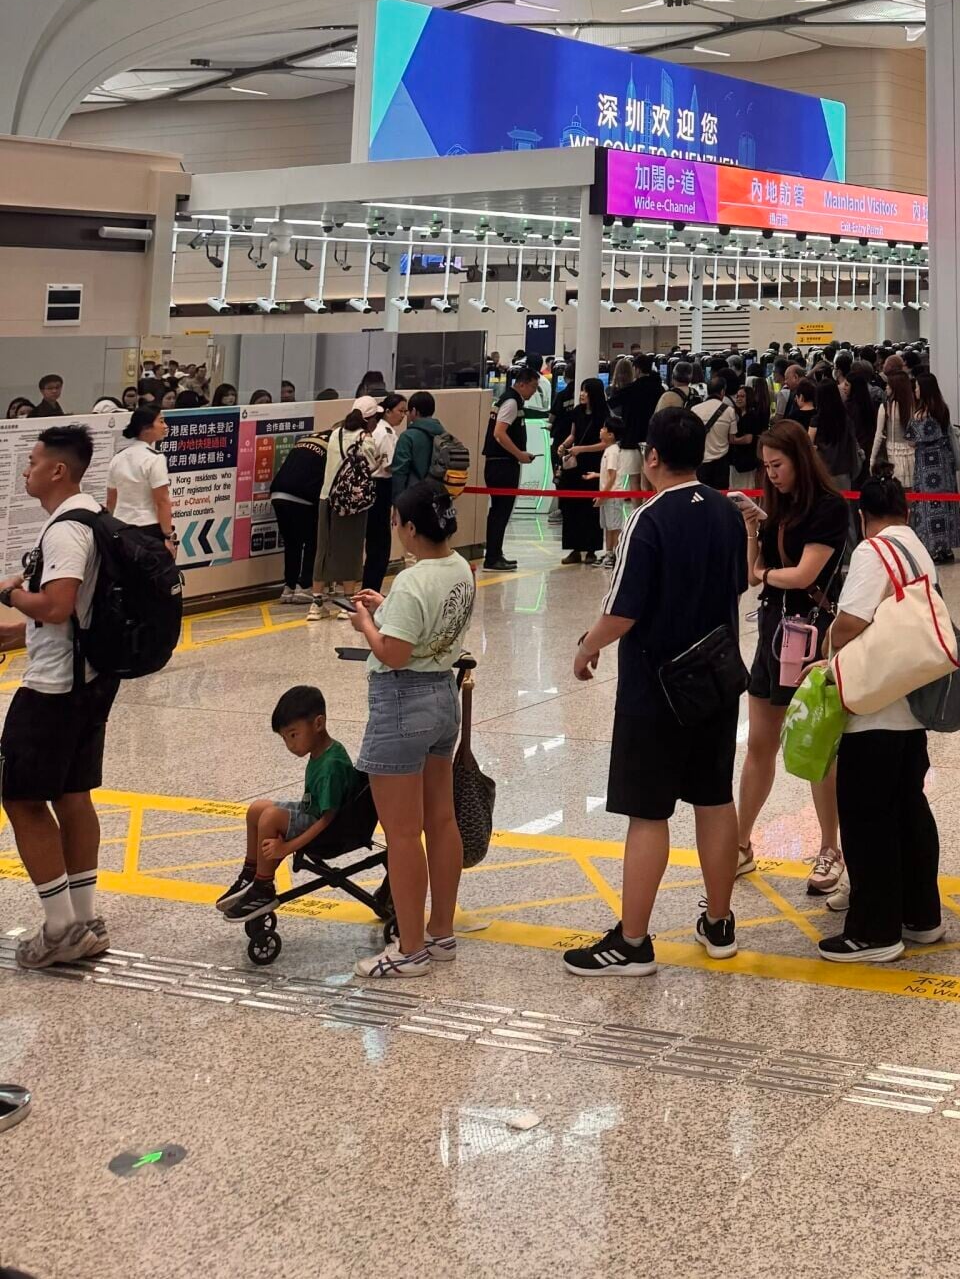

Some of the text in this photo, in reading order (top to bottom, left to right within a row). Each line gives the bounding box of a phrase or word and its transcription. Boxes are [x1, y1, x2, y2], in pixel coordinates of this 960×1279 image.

[597, 93, 718, 146] 深圳欢迎您
[634, 195, 696, 215] Wide e-Channel
[823, 190, 898, 217] Mainland Visitors
[165, 422, 234, 437] 港居民如未登記
[176, 475, 191, 485] Kong
[195, 473, 217, 482] residents
[221, 471, 232, 479] who
[172, 482, 231, 495] NOT registered for the
[214, 494, 230, 503] please
[903, 985, 927, 994] No
